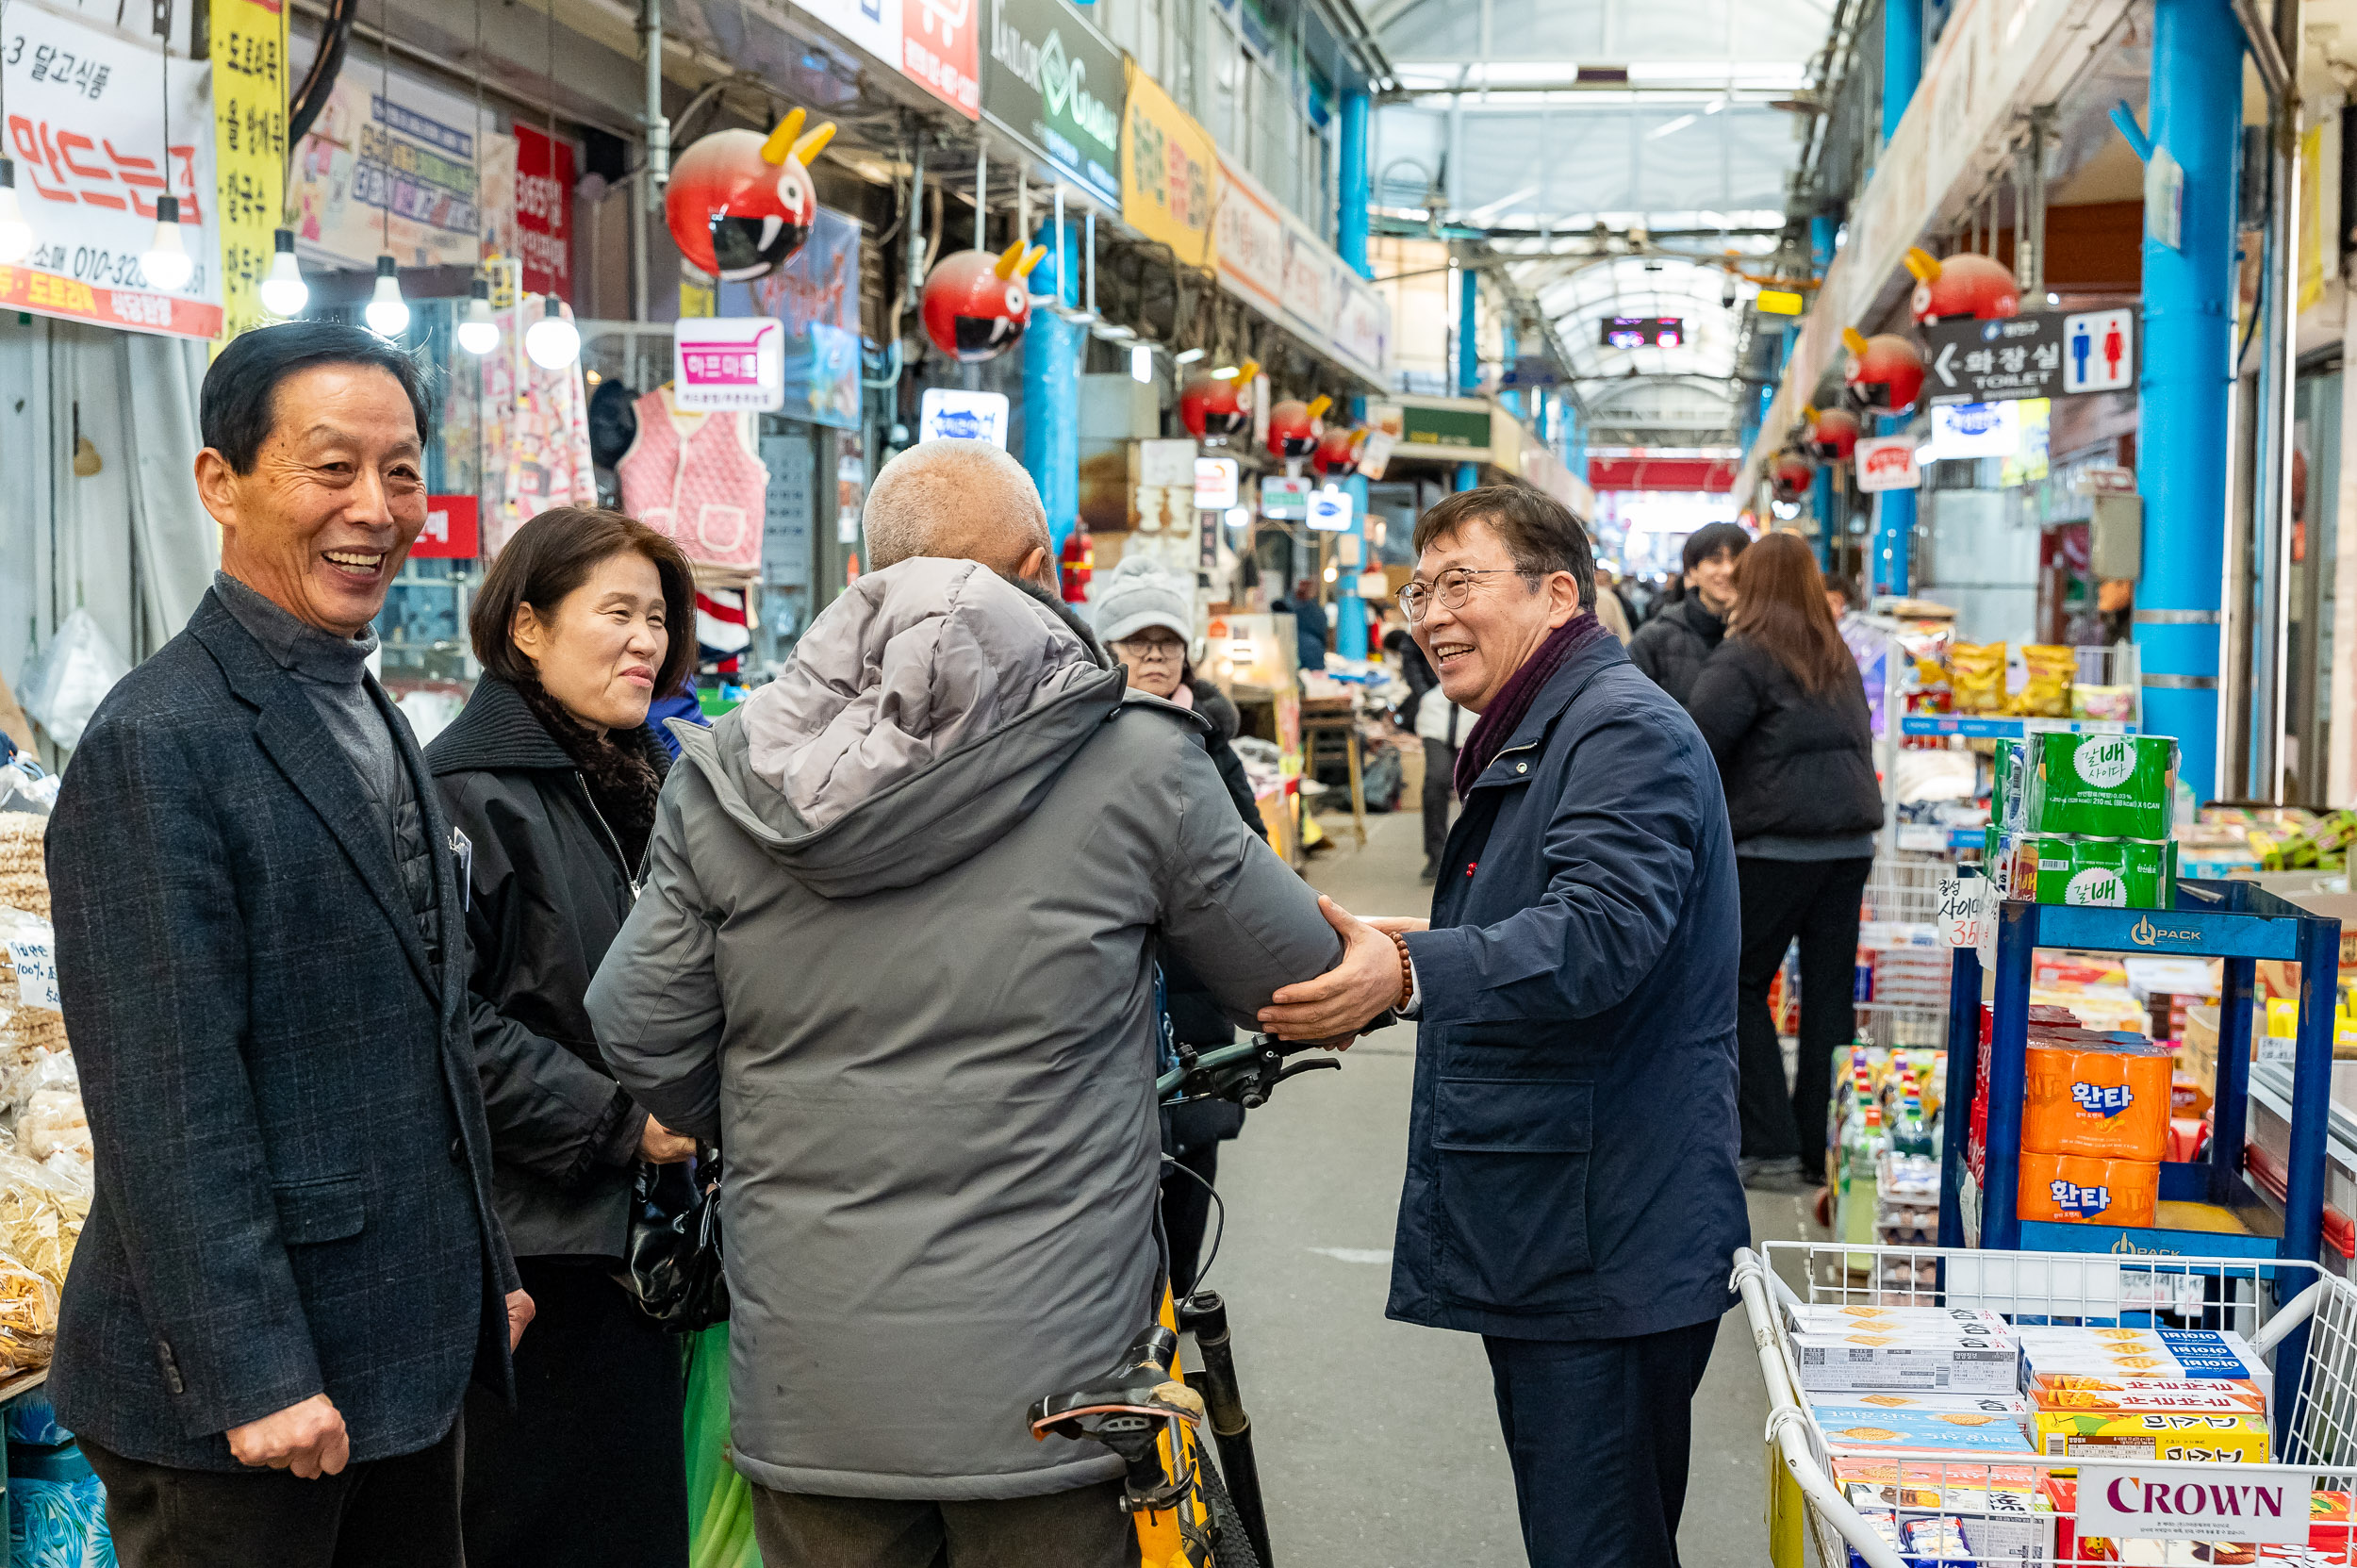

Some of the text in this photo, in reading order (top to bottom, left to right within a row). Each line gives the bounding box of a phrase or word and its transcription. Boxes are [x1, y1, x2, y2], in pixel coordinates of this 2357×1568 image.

[31, 44, 110, 100] 달고식품
[28, 272, 97, 315] 도토리
[1964, 341, 2059, 374] 화장실
[1972, 370, 2052, 389] TOILET
[2082, 742, 2125, 767] 갈배
[2088, 764, 2126, 779] 사이다
[1938, 879, 1960, 897] 칠성
[2074, 879, 2117, 904] 갈배
[1949, 920, 1978, 946] 35
[2070, 1081, 2134, 1109] 환타
[2050, 1180, 2112, 1210] 환타
[2106, 1477, 2283, 1517] CROWN
